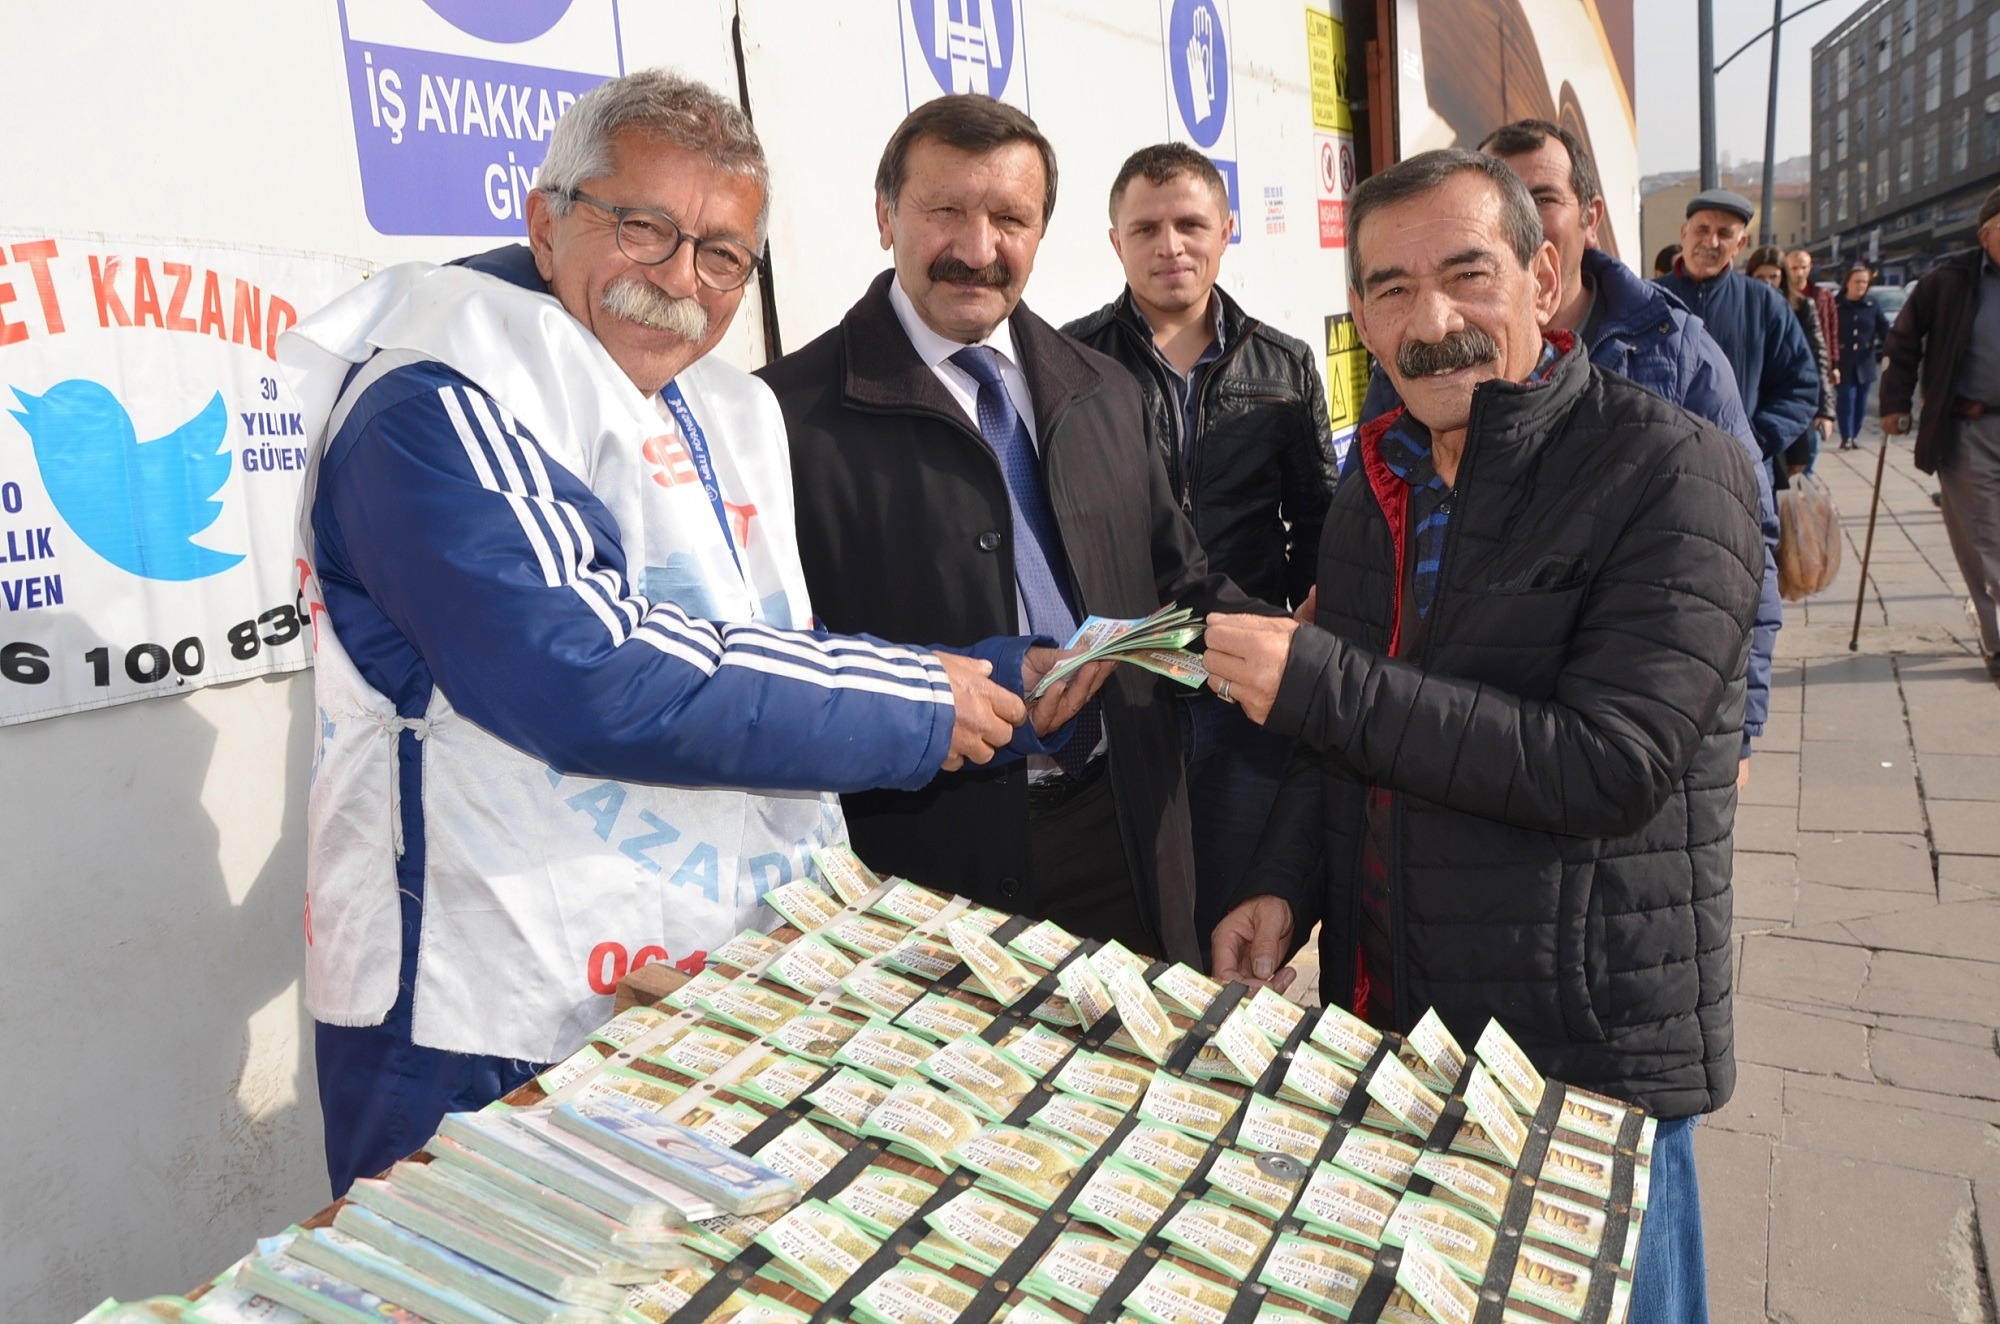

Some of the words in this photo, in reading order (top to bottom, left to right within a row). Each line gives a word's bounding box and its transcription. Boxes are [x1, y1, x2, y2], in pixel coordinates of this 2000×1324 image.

[364, 51, 406, 144] İŞ
[260, 377, 278, 401] 30
[242, 442, 307, 472] GÜVEN
[0, 574, 64, 612] VEN
[85, 636, 205, 687] 100
